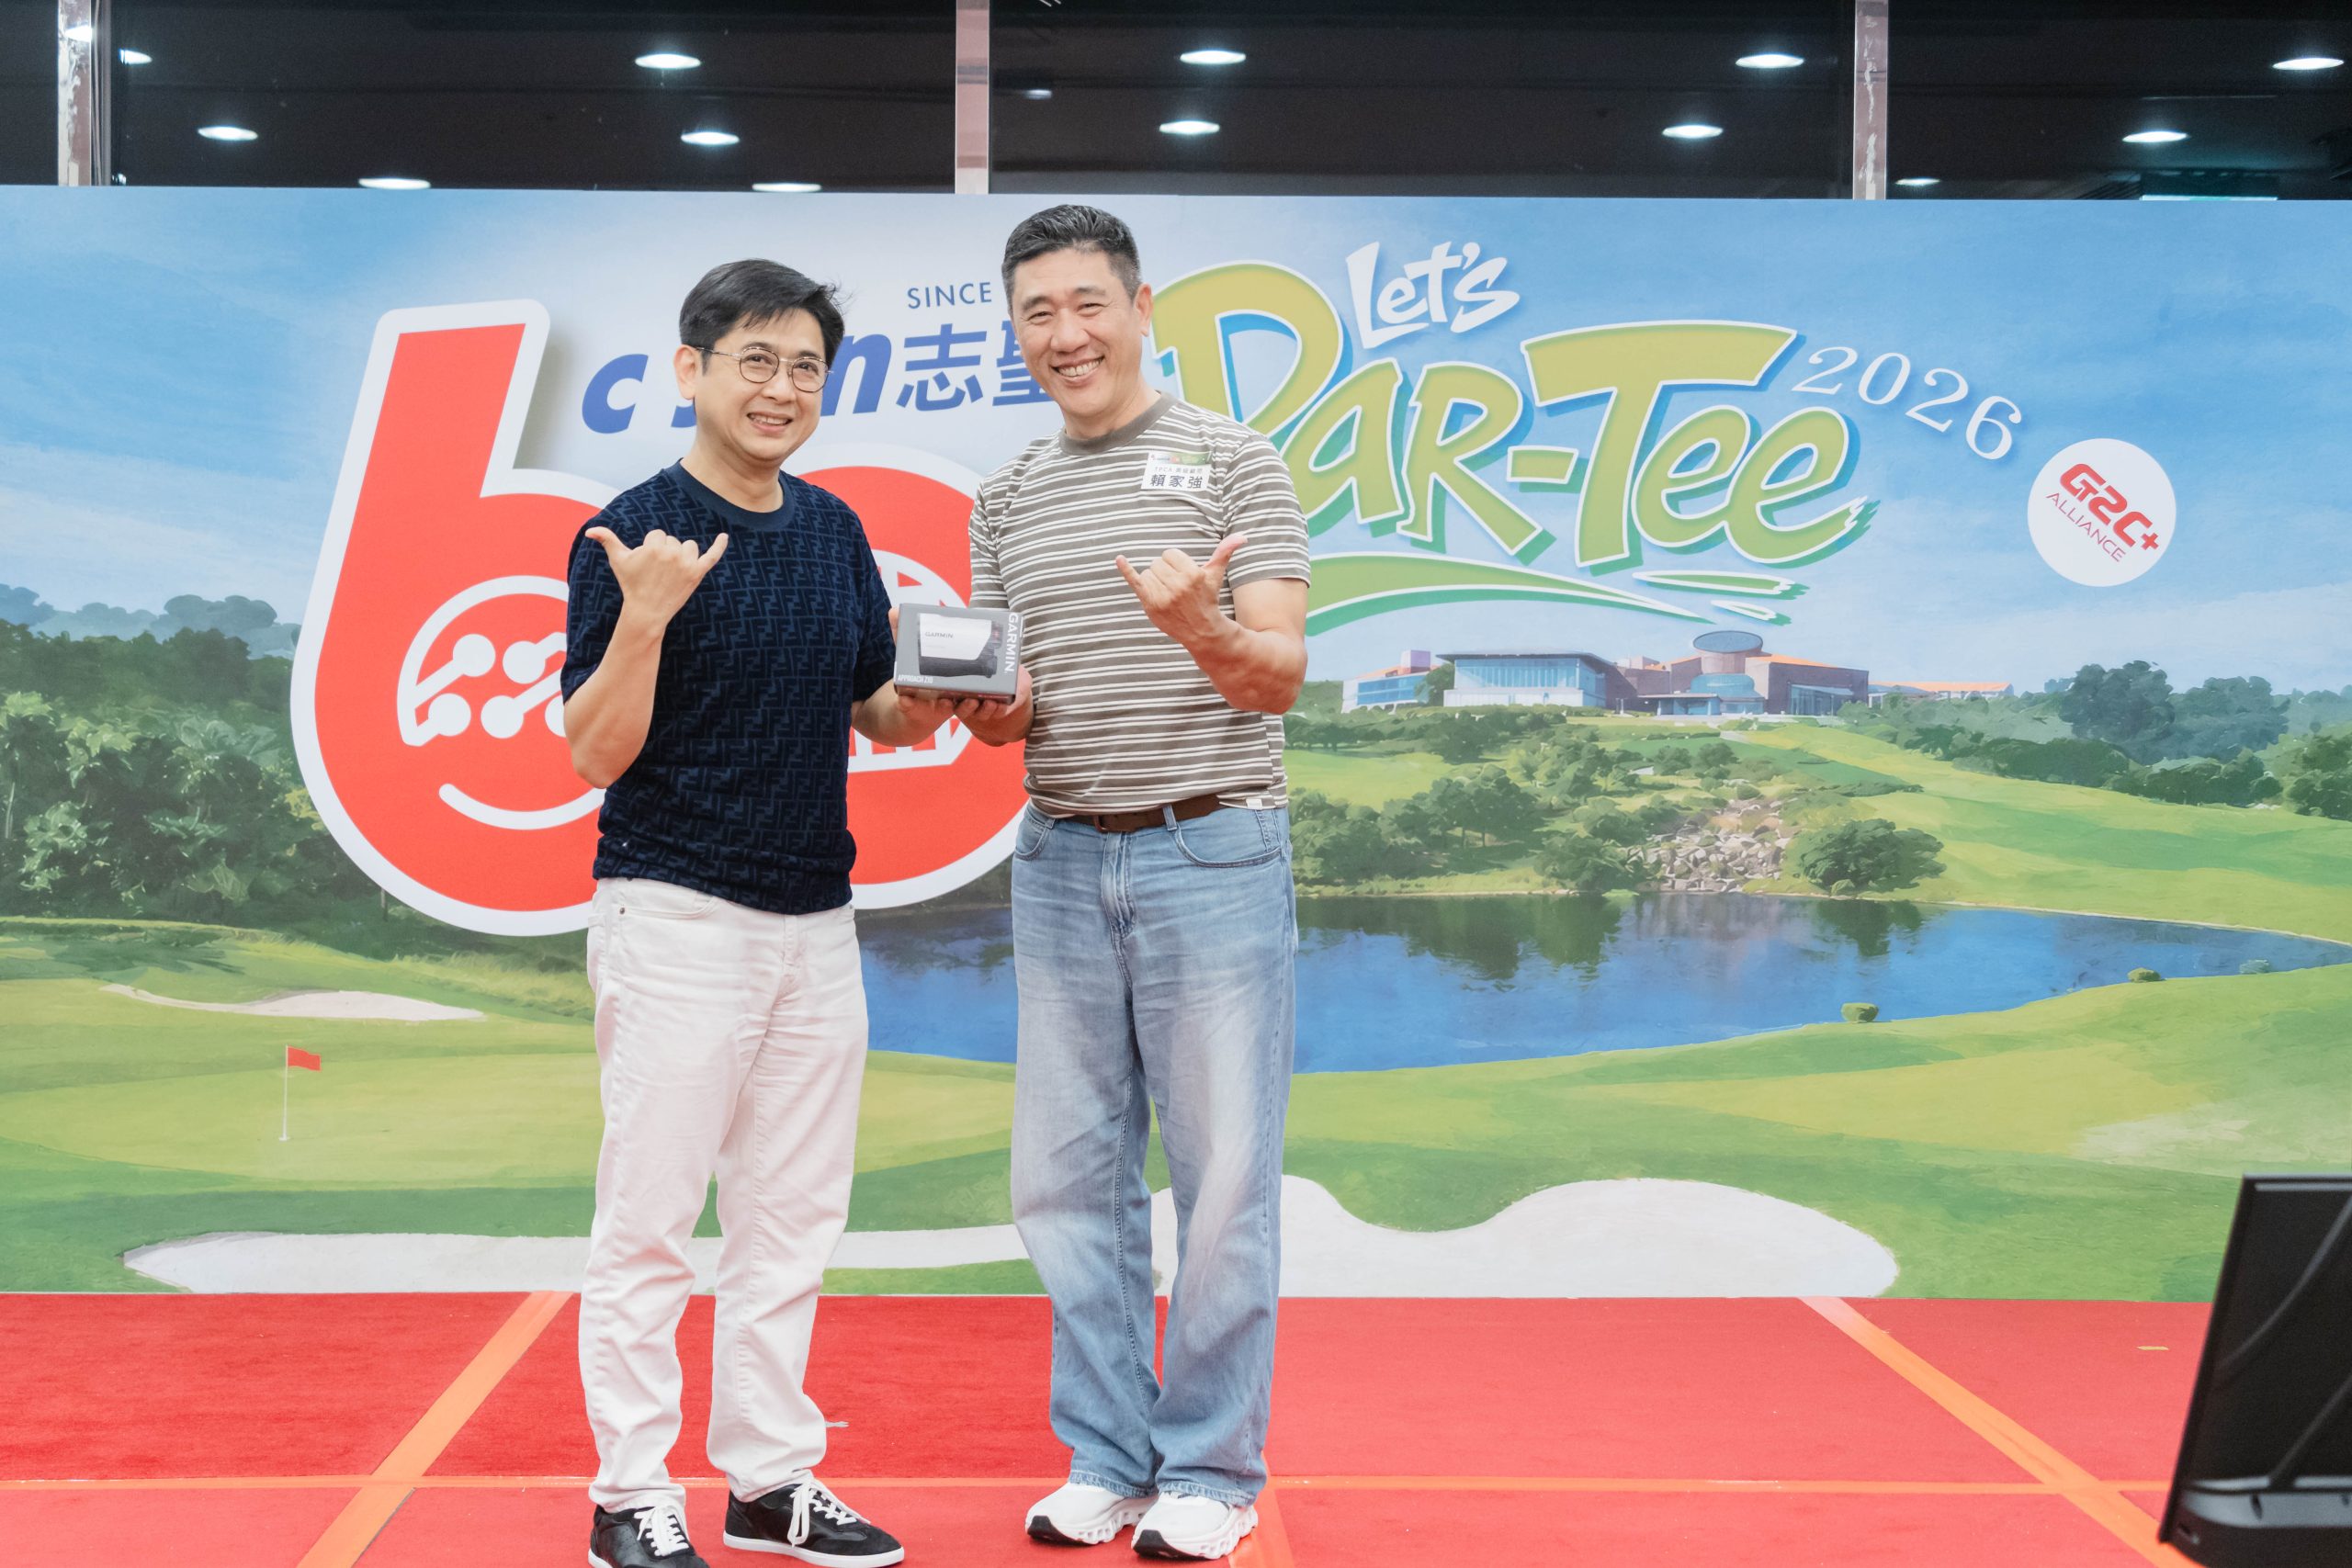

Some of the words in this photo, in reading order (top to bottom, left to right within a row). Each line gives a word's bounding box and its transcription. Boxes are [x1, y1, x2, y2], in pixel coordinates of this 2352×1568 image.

[907, 281, 992, 310] SINCE
[1345, 242, 1521, 349] Let's
[1792, 346, 2022, 460] 2026
[1150, 474, 1203, 489] 賴家強
[2046, 492, 2127, 563] ALLIANCE
[1004, 613, 1019, 673] GARMIN
